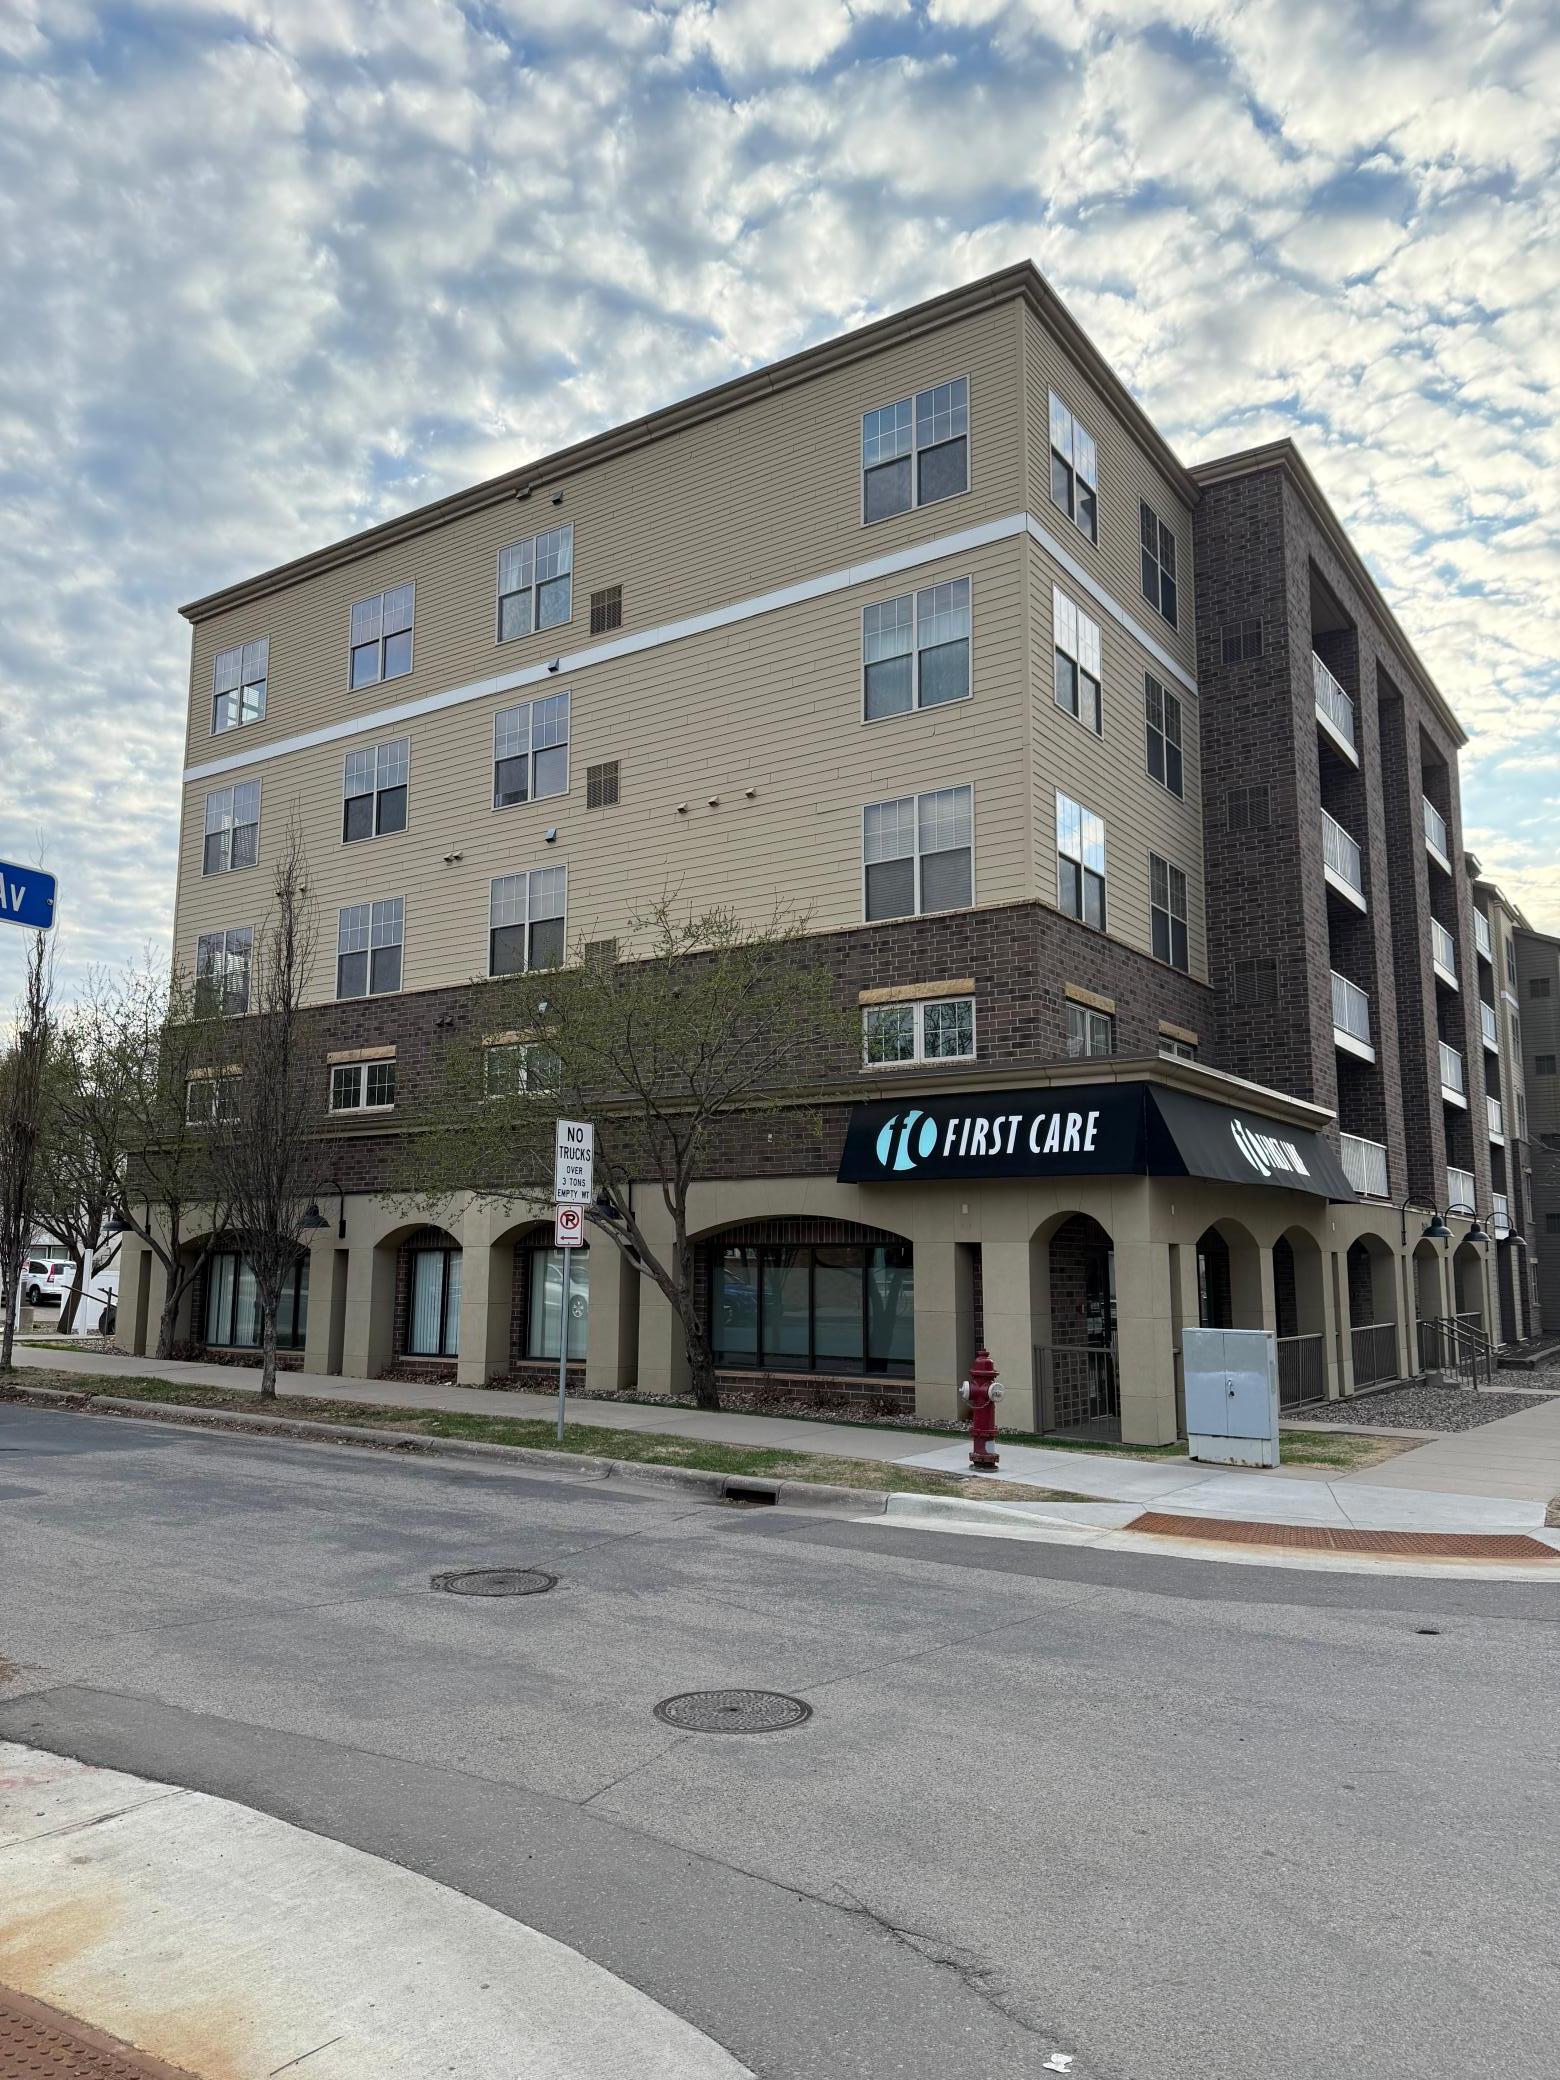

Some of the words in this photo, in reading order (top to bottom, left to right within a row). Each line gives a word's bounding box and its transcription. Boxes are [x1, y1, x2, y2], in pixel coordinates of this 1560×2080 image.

[567, 1126, 584, 1143] NO
[942, 1115, 1023, 1157] FIRST
[1029, 1111, 1100, 1154] CARE
[559, 1145, 591, 1162] TRUCKS
[566, 1165, 583, 1175] OVER
[562, 1177, 567, 1186] 3
[569, 1177, 586, 1187] TONS
[557, 1188, 578, 1199] EMPTY
[581, 1190, 590, 1199] WT
